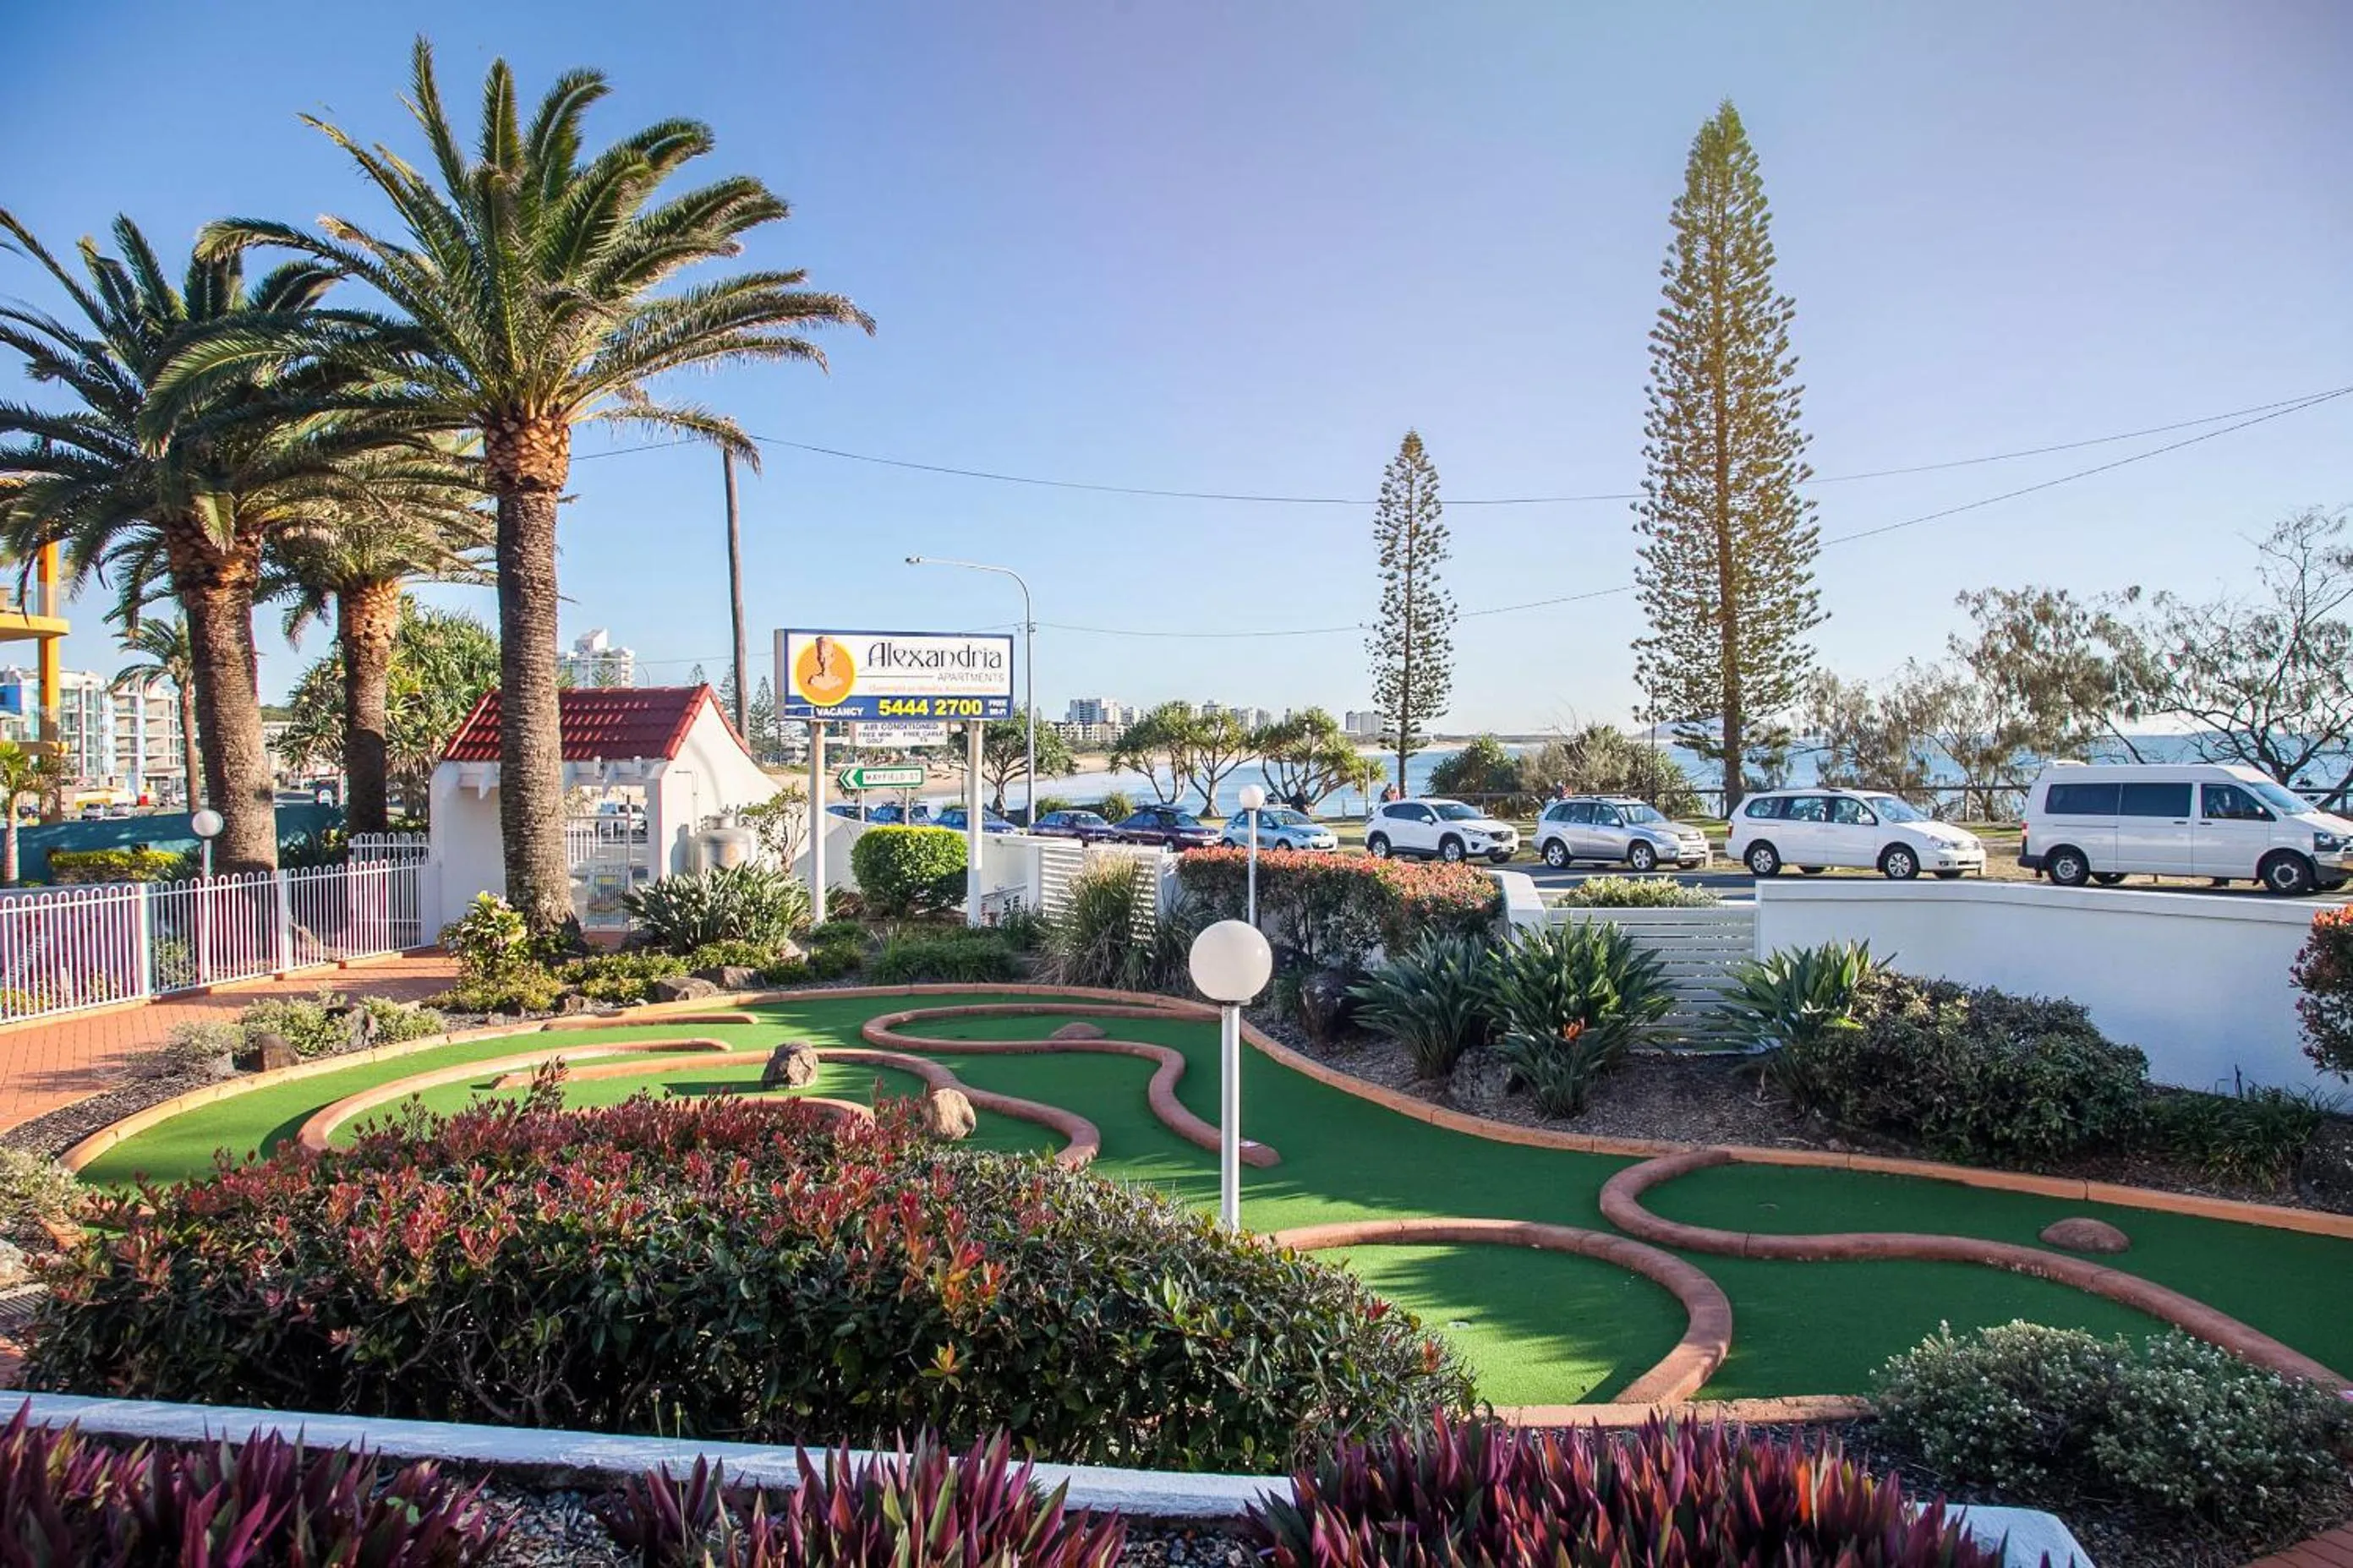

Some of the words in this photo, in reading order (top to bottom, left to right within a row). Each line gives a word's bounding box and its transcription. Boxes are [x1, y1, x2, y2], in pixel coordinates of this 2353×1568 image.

[868, 642, 1002, 669] Alexandria
[938, 673, 1004, 683] APARTMENTS
[815, 707, 864, 717] VACANCY
[878, 699, 929, 716] 5444
[934, 700, 982, 716] 2700
